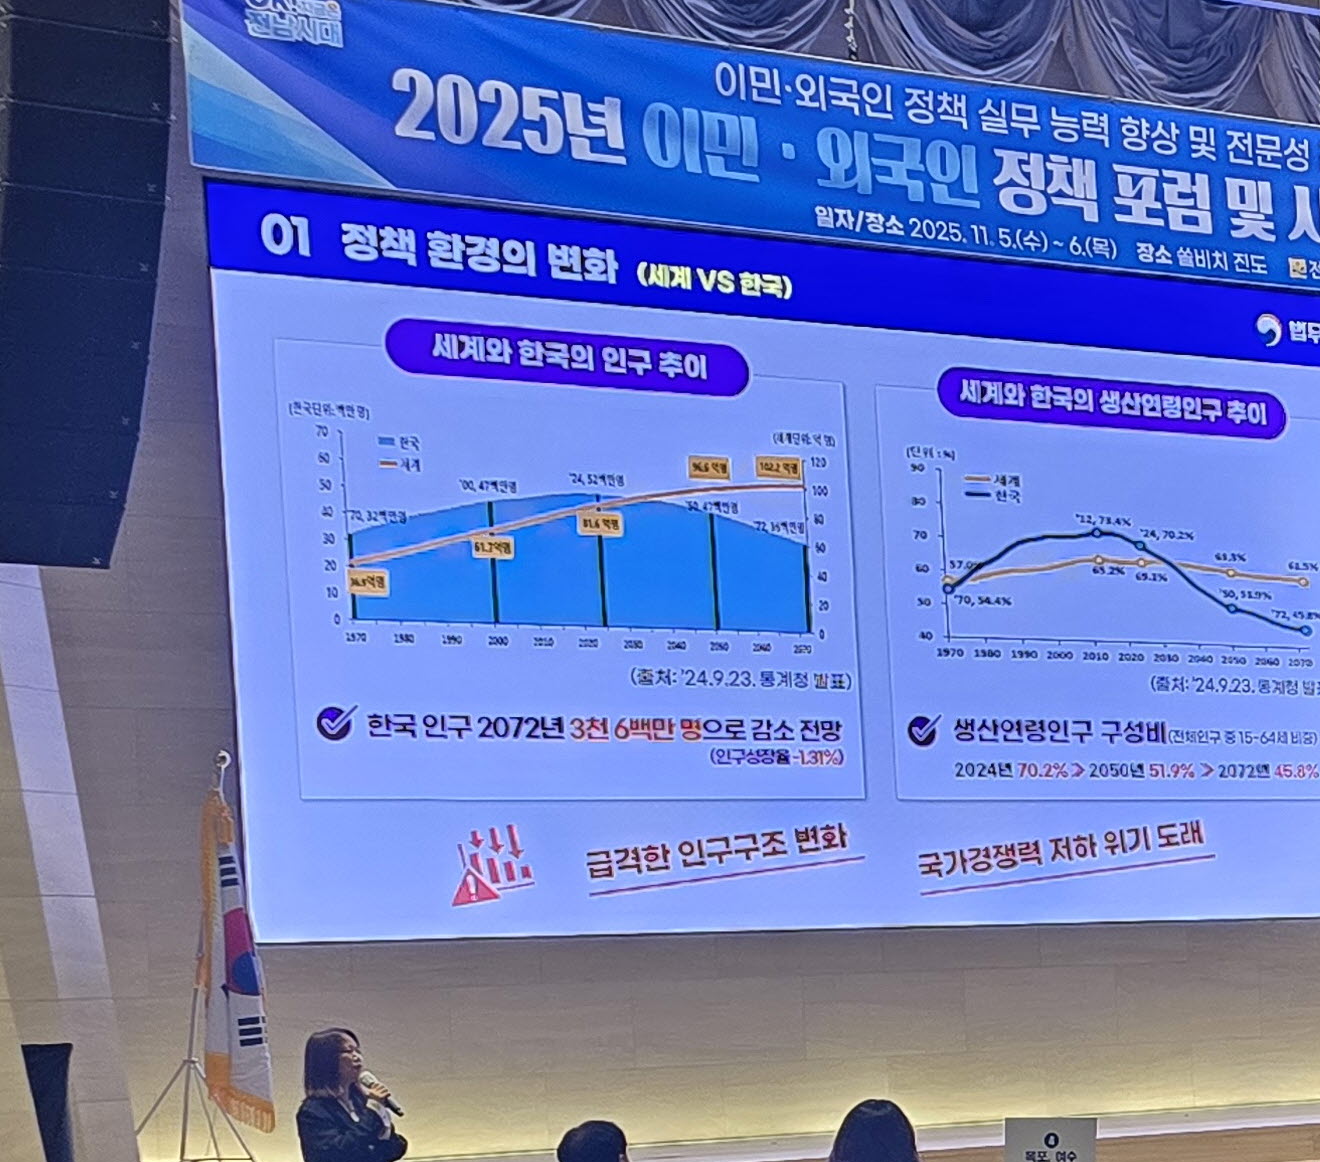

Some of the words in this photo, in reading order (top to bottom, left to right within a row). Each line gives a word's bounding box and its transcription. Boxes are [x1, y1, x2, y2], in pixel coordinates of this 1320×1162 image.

[246, 9, 343, 48] 전남시대
[715, 61, 893, 120] 이민·외국인
[904, 87, 968, 130] 정책
[978, 97, 1041, 139] 실무
[1050, 107, 1110, 148] 능력
[1120, 115, 1180, 155] 향상
[1188, 125, 1217, 162] 및
[1226, 130, 1310, 172] 전문성
[392, 67, 627, 165] 2025년
[642, 102, 760, 183] 이민
[816, 127, 980, 208] 외국인
[993, 149, 1099, 223] 정책
[1112, 163, 1213, 235] 포럼
[1225, 176, 1277, 243] 및
[261, 213, 311, 257] 01
[341, 222, 417, 267] 정책
[426, 229, 537, 276] 환경의
[547, 243, 619, 284] 변화
[636, 261, 692, 290] (세계
[696, 267, 735, 294] VS
[740, 271, 792, 300] 한국)
[814, 205, 905, 236] 일자/장소
[909, 217, 967, 243] 2025.
[970, 225, 996, 246] 11.
[998, 228, 1048, 253] 5.(수)
[1069, 236, 1118, 260] 6.(목)
[1136, 242, 1173, 265] 장소
[1234, 252, 1268, 274] 진도
[432, 332, 513, 365] 세계와
[517, 338, 595, 372] 한국의
[601, 347, 652, 376] 인구
[659, 351, 708, 380] 추이
[960, 378, 1025, 407] 세계와
[1030, 384, 1094, 412] 한국의
[1099, 389, 1223, 422] 생산연령인구
[1227, 400, 1267, 425] 추이
[913, 530, 928, 540] 70
[324, 559, 337, 571] 20
[326, 586, 338, 598] 10
[334, 612, 341, 625] 0
[819, 629, 825, 640] 0
[1046, 650, 1074, 660] 2000
[1082, 651, 1109, 661] 2010
[1118, 652, 1145, 662] 2020
[367, 713, 417, 738] 한국
[422, 714, 473, 739] 인구
[477, 716, 566, 740] 2072년
[570, 716, 609, 741] 3천
[614, 717, 676, 741] 6백만
[680, 718, 747, 741] 명으로
[751, 719, 795, 741] 감소
[800, 719, 843, 742] 전망
[954, 718, 1094, 744] 생산연령인구
[955, 762, 1014, 778] 2024년
[1017, 763, 1069, 778] 70.2%
[1089, 763, 1146, 779] 2050년
[1149, 763, 1195, 779] 51.9%
[1218, 763, 1271, 779] 2072년
[1274, 763, 1320, 779] 45.8%
[587, 843, 671, 879] 급격한
[677, 831, 788, 868] 인구구조
[794, 822, 848, 853] 변화
[918, 839, 1044, 878] 국가경쟁력
[1049, 834, 1097, 862] 저하
[1104, 826, 1151, 855] 위기
[1158, 820, 1205, 848] 도래
